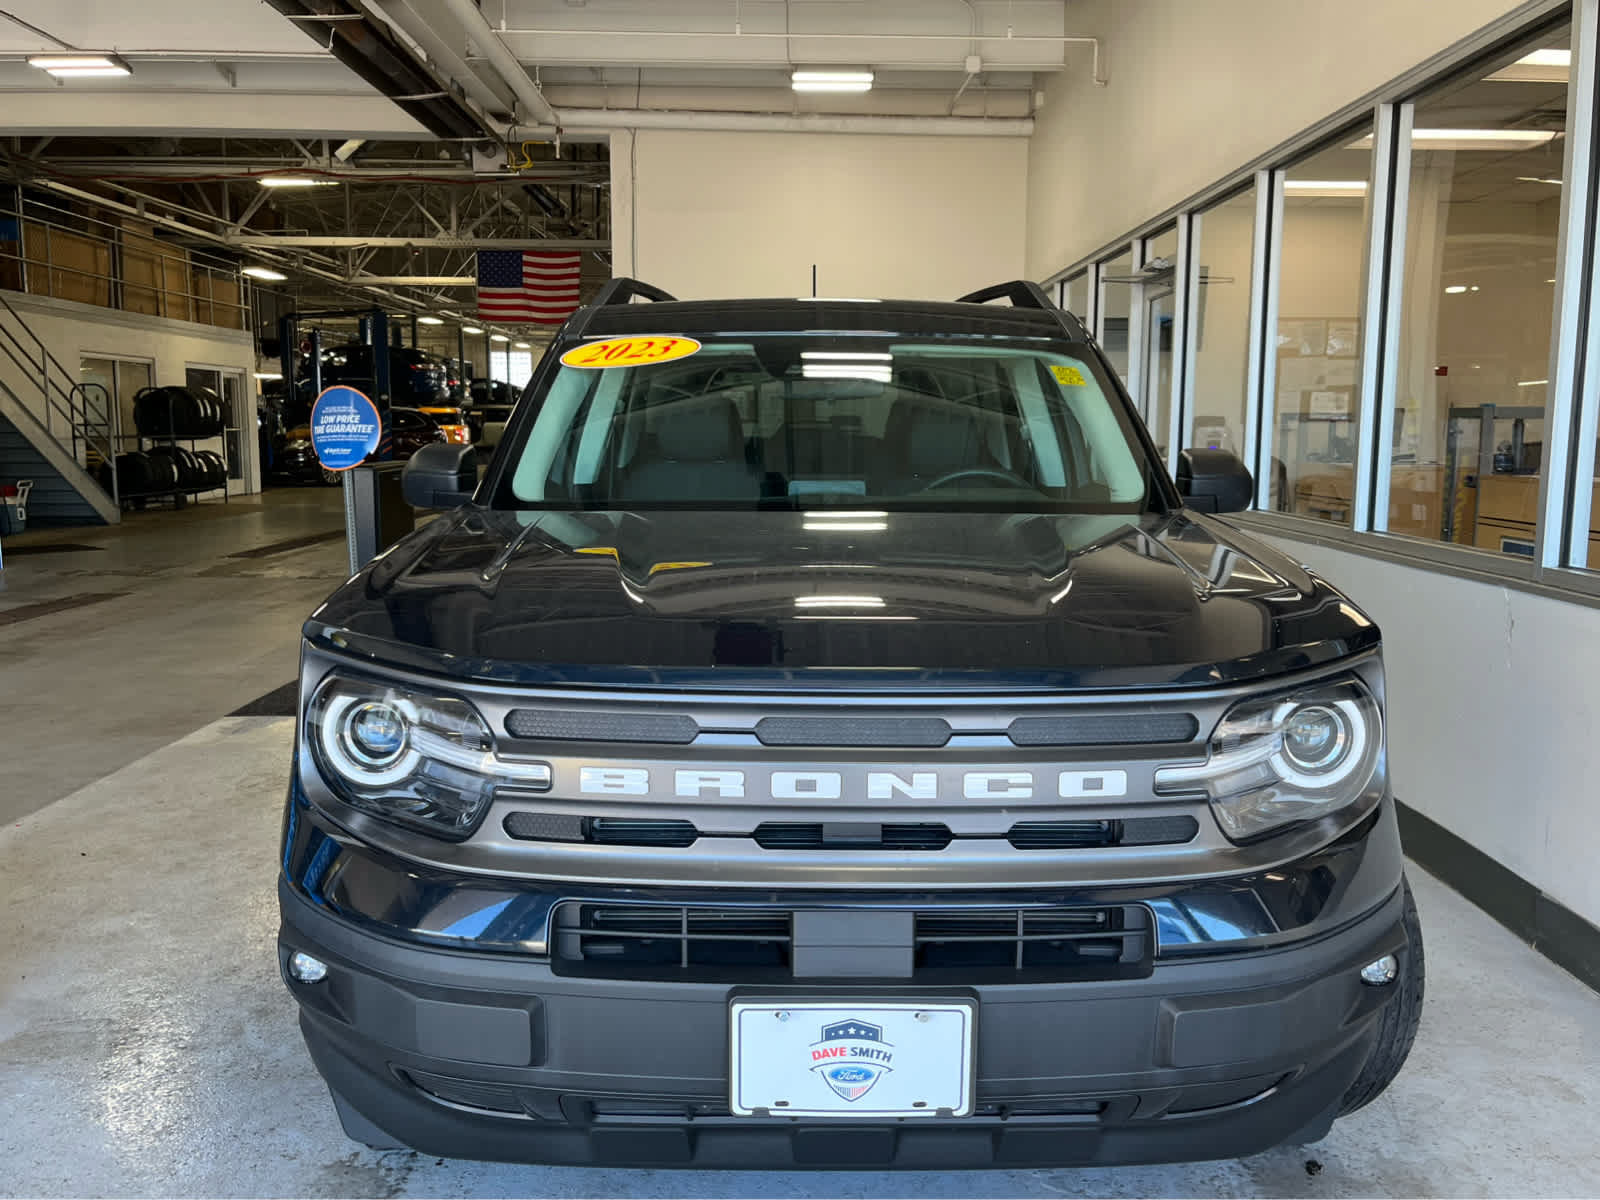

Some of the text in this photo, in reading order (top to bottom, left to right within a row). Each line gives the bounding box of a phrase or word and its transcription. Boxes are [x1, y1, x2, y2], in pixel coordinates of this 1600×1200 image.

[580, 340, 678, 363] 2023
[320, 414, 360, 425] LOW PRICE
[325, 424, 376, 434] GUARANTEE
[579, 767, 1128, 799] BRONCO
[812, 1046, 893, 1062] DAVE SMITH
[838, 1070, 865, 1081] Ford
